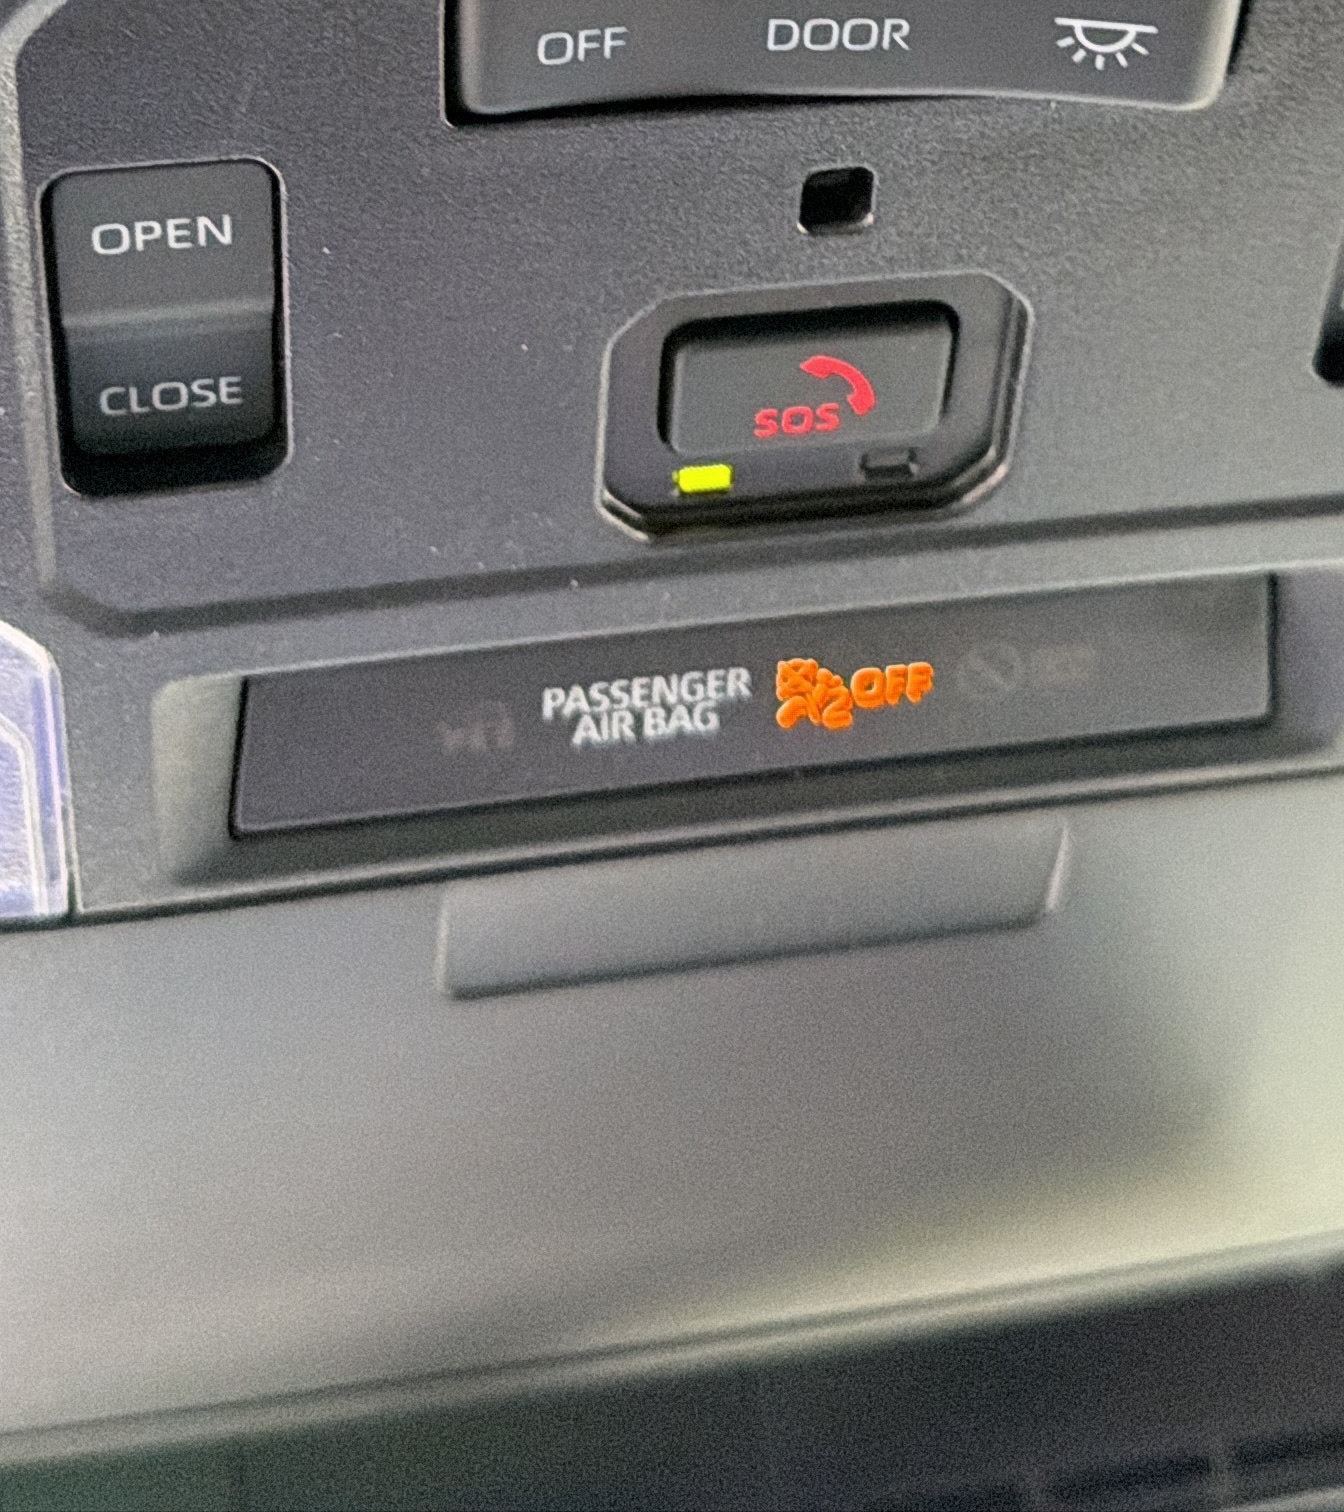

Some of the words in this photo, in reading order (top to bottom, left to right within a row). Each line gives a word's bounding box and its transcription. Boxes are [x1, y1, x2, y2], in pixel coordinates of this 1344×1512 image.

[536, 26, 628, 66] OFF
[766, 17, 911, 52] DOOR
[91, 214, 233, 256] OPEN
[99, 376, 244, 415] CLOSE
[753, 402, 841, 439] SOS
[542, 666, 752, 720] PASSENGER
[851, 660, 935, 710] OFF
[571, 706, 637, 746] AIR
[642, 699, 721, 739] BAG
